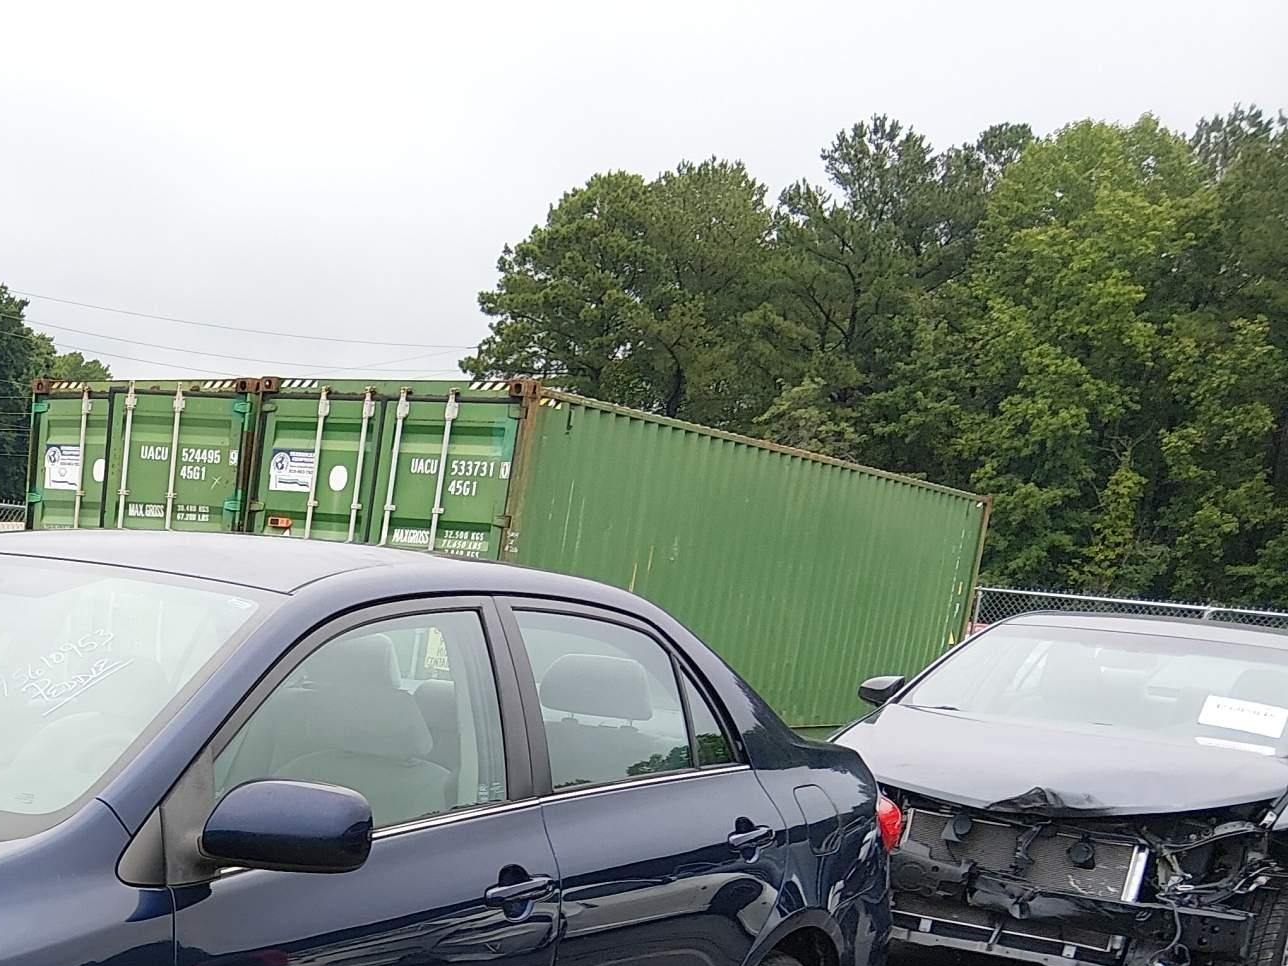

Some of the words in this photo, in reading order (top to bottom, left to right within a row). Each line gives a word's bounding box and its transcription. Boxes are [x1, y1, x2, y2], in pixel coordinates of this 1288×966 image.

[140, 445, 169, 461] UACU
[181, 447, 221, 464] 524495
[179, 465, 206, 480] 45G1
[410, 458, 439, 474] UACU
[450, 460, 495, 477] 533731
[447, 479, 478, 497] 45G1
